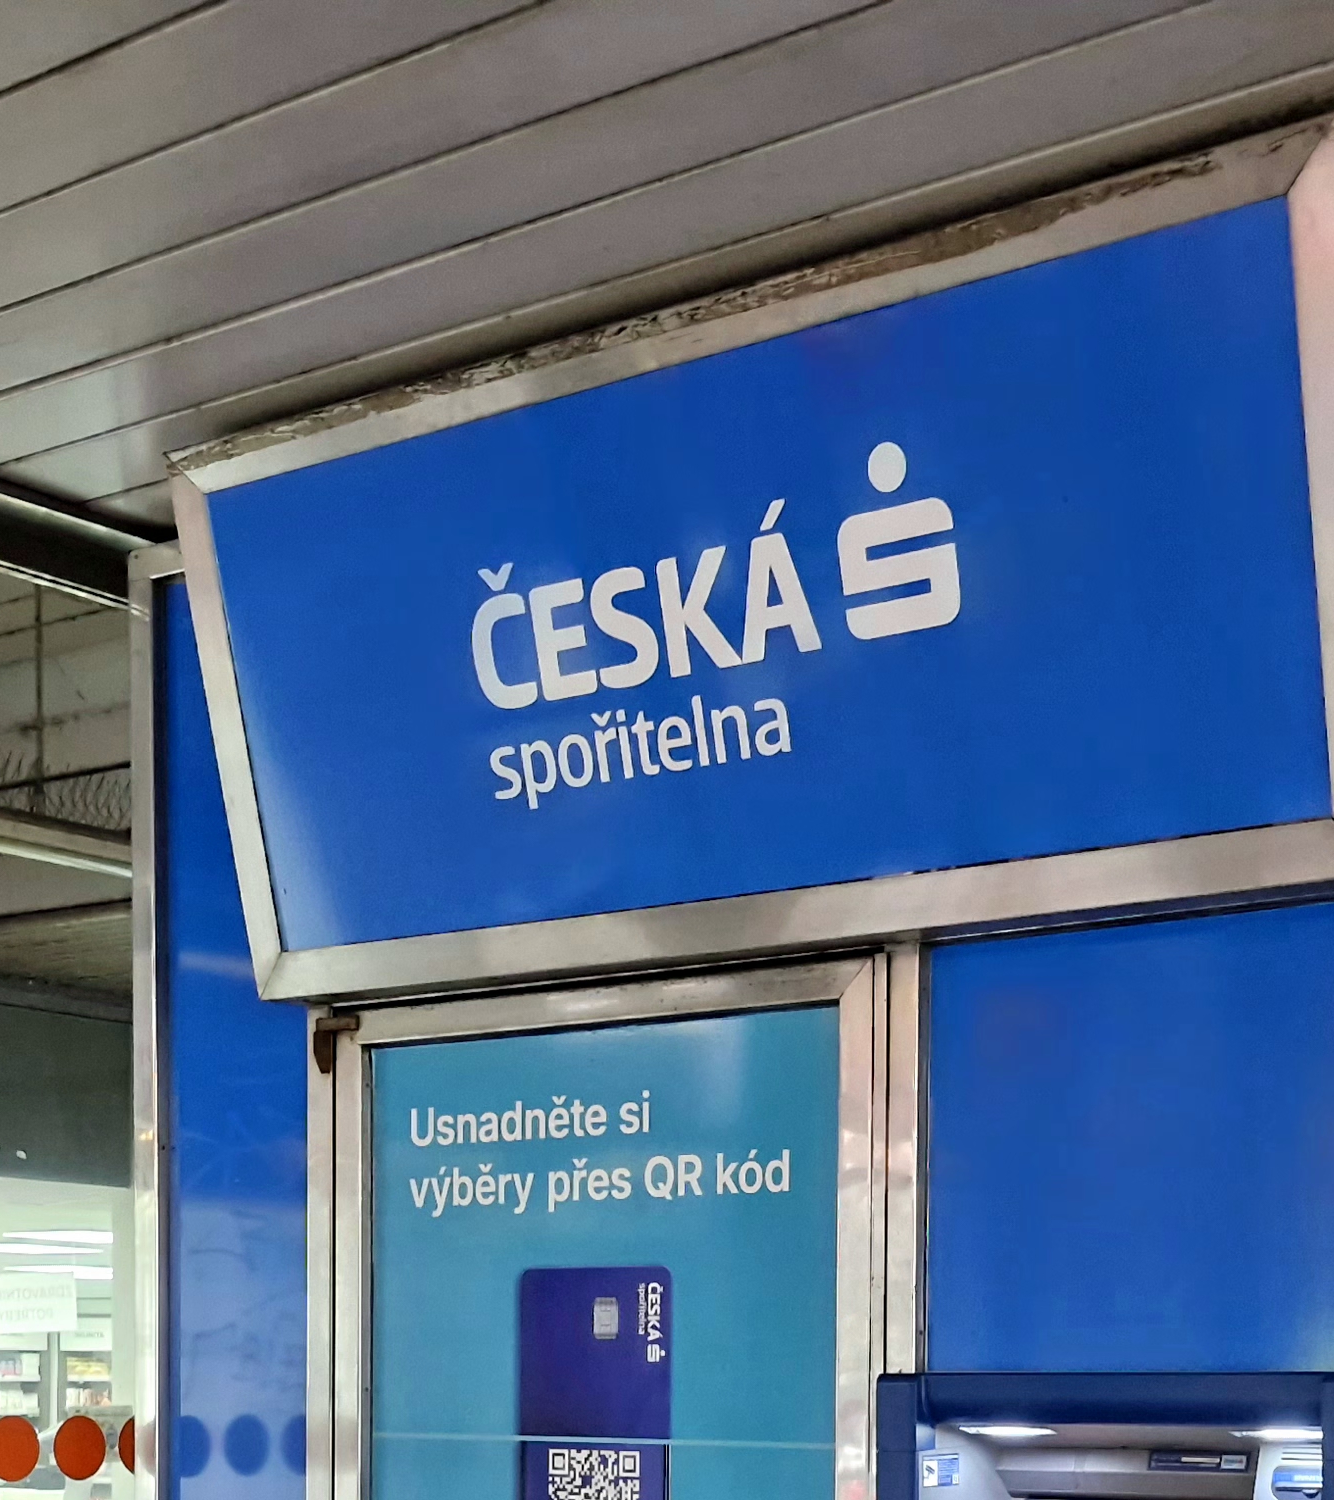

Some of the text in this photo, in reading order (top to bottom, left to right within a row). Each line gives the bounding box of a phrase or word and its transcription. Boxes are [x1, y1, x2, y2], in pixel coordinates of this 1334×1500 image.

[471, 498, 823, 710] ČESKÁ
[489, 694, 792, 810] spořitelna
[409, 1089, 651, 1148] Usnadněte si
[409, 1149, 791, 1218] výběry přes QR kód
[647, 1282, 664, 1342] ČESKÁ
